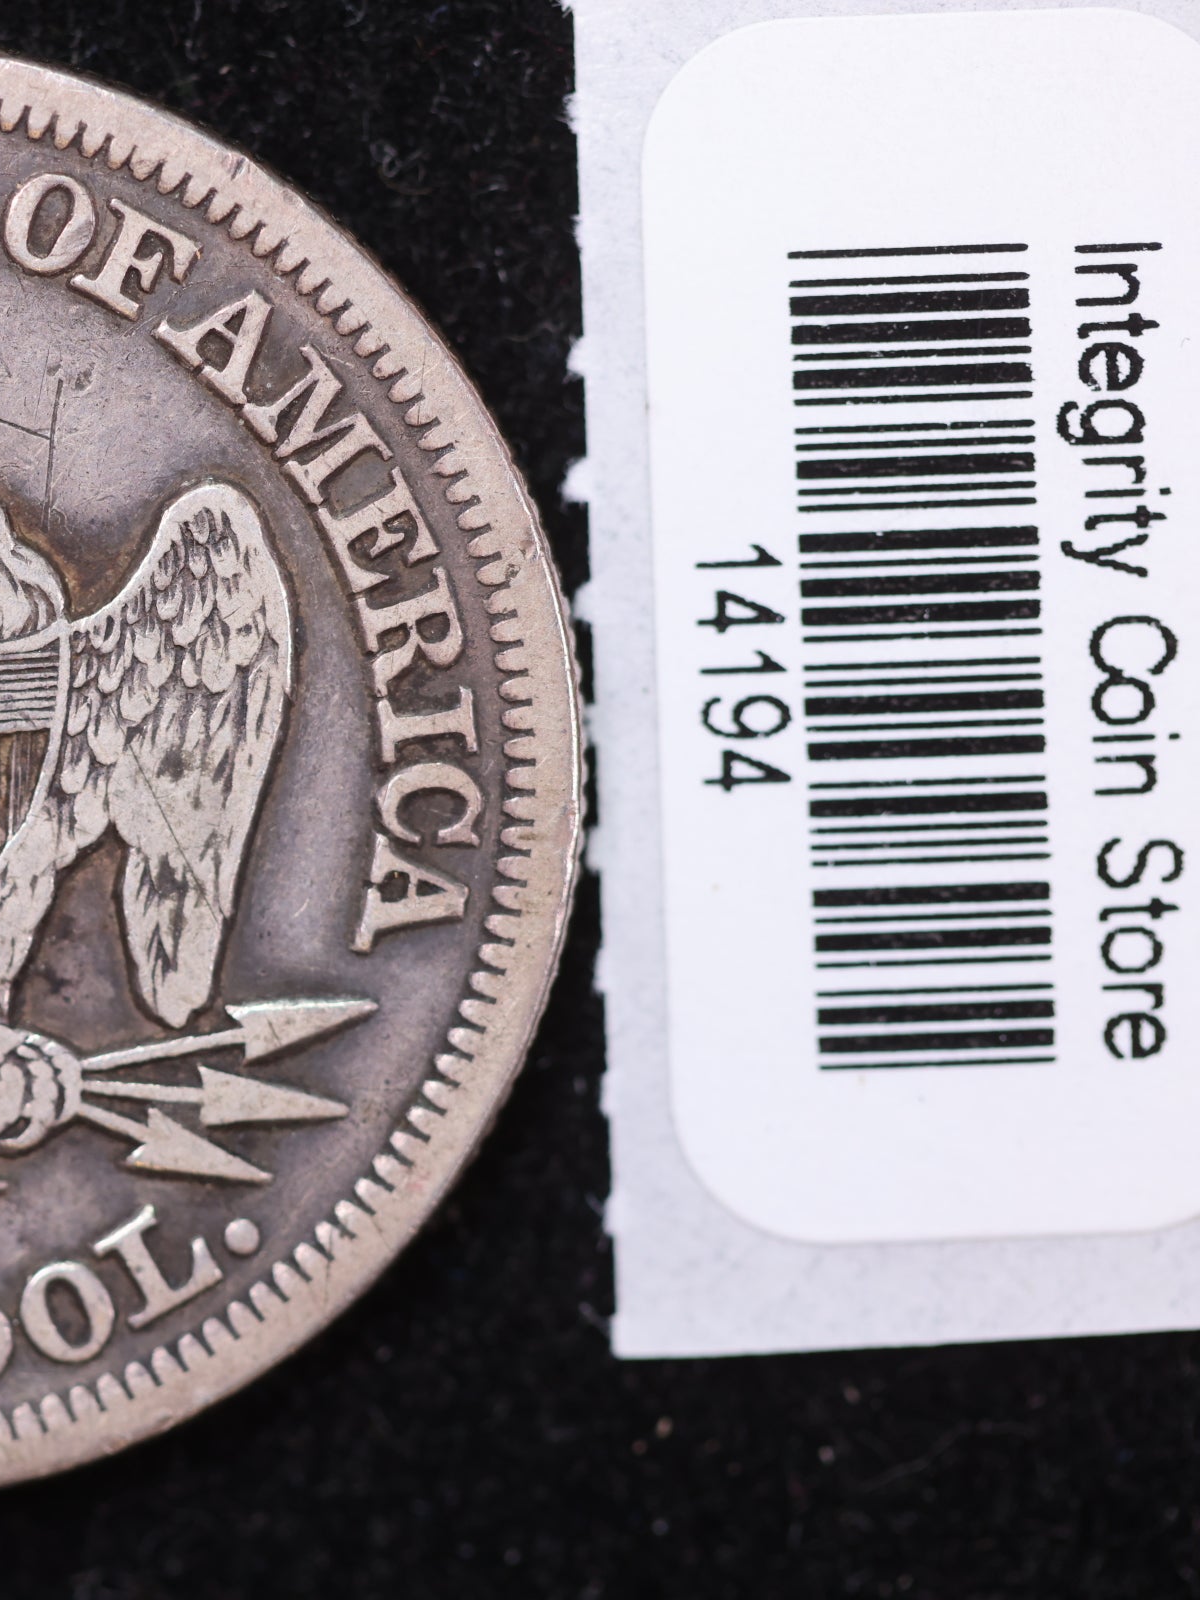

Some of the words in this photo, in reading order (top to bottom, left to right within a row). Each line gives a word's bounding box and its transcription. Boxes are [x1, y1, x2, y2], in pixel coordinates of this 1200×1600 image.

[1056, 242, 1172, 577] Integrity
[4, 172, 200, 316] OF
[157, 289, 485, 952] AMERICA
[694, 543, 792, 792] 14194
[1088, 615, 1181, 796] Coin
[1097, 838, 1185, 1061] Store
